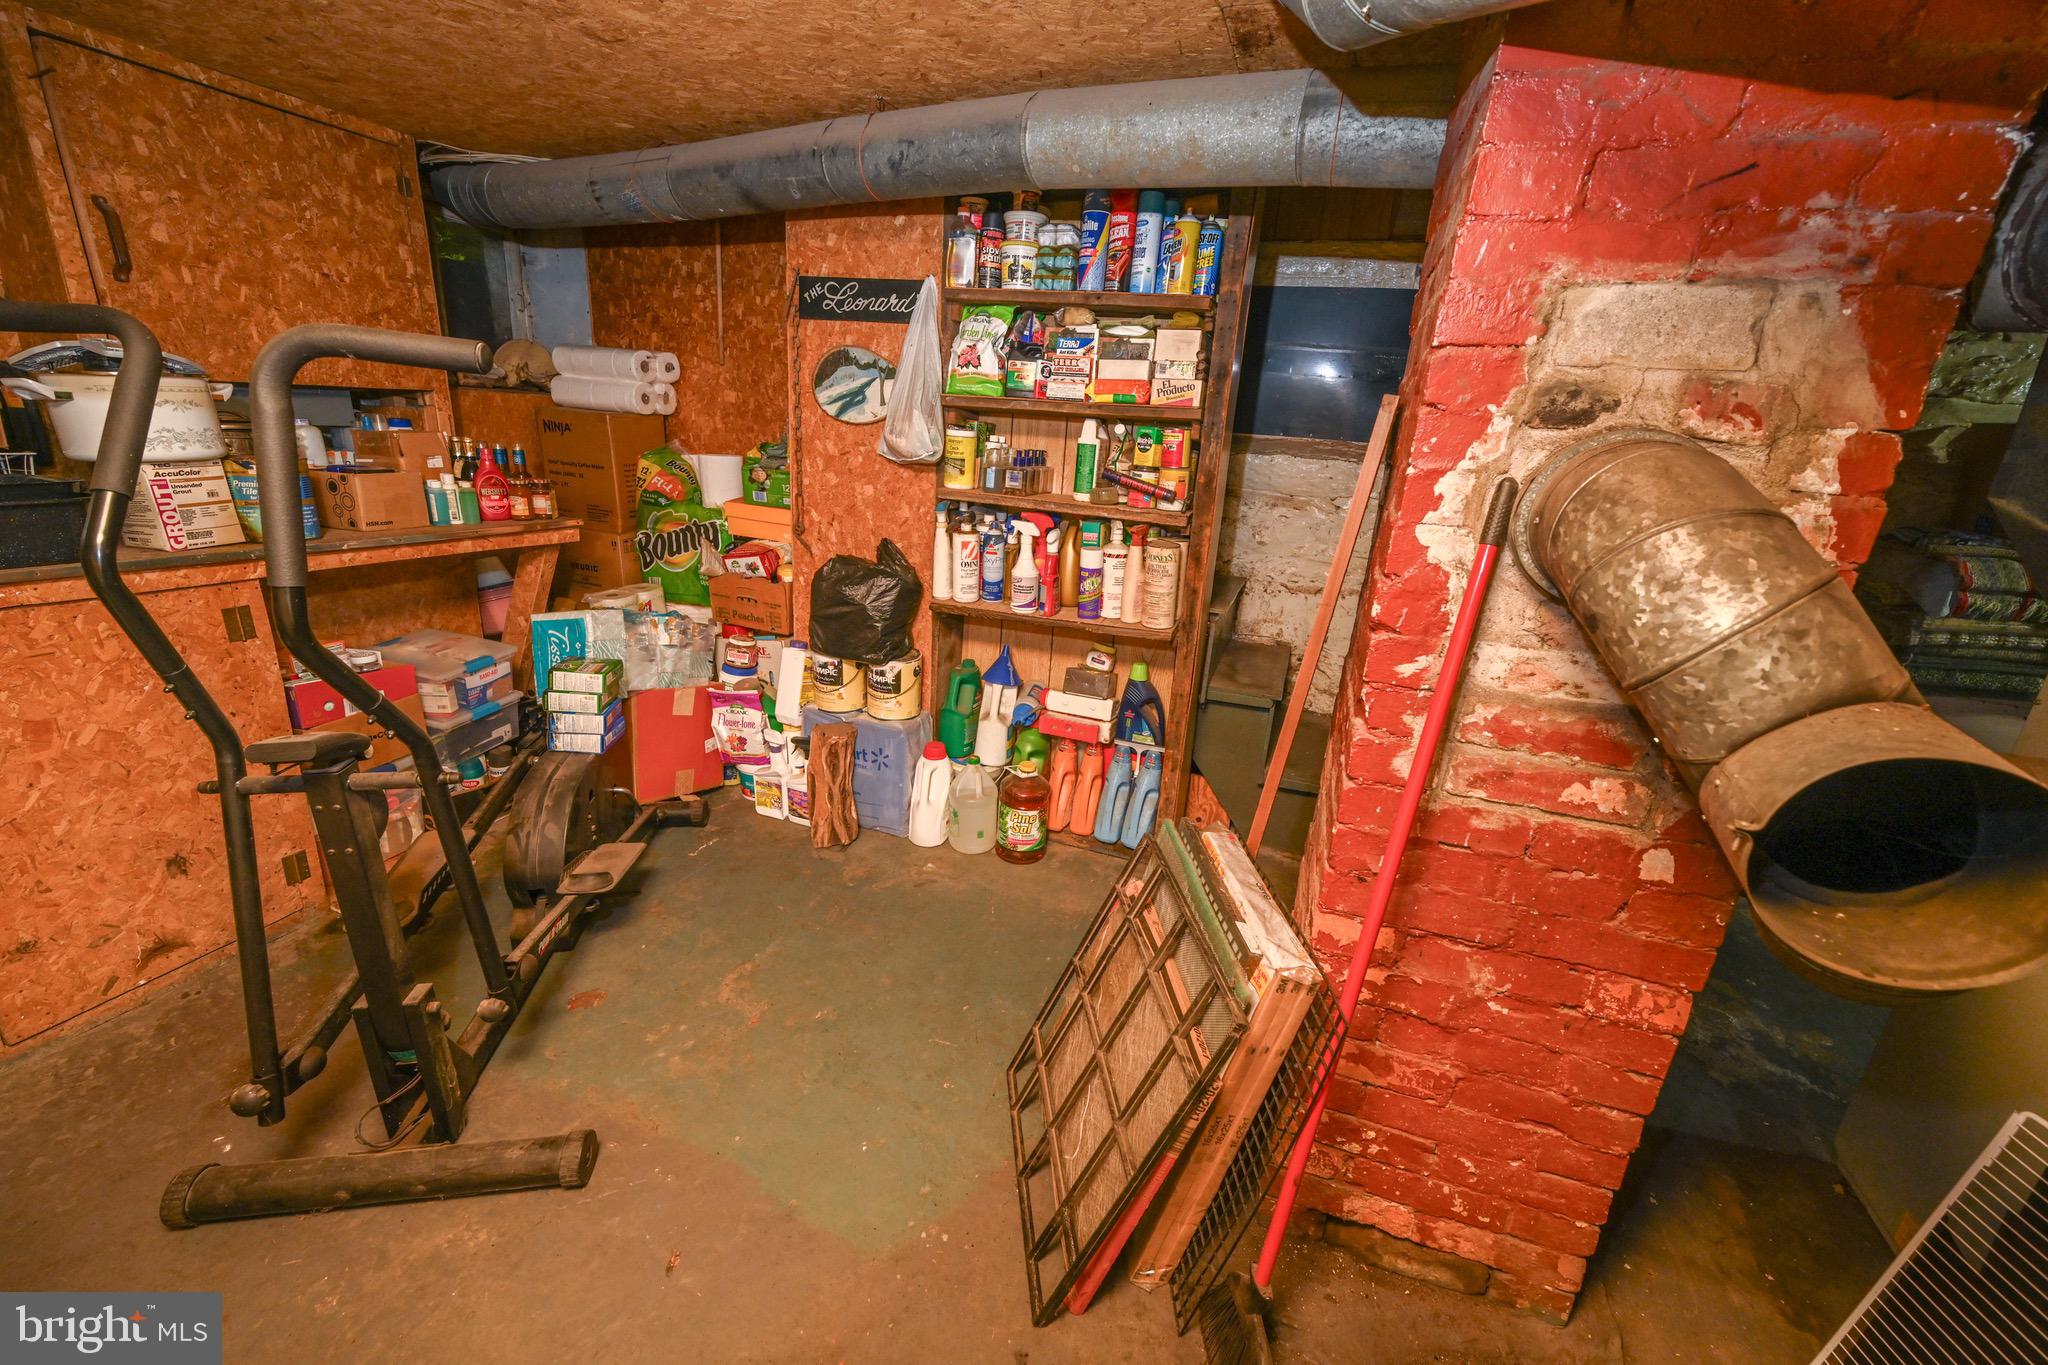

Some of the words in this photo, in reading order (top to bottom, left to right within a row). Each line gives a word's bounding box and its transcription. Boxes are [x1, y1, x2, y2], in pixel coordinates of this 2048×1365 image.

[803, 282, 825, 303] THE
[1059, 339, 1080, 348] TERRO
[1157, 383, 1196, 398] Producto
[543, 419, 571, 436] NINJA
[154, 470, 201, 478] AccuColor
[665, 459, 697, 487] Bounty
[233, 480, 258, 488] Premi
[637, 519, 721, 572] Bounty
[732, 610, 765, 624] Peaches
[480, 669, 499, 681] BAND-AID
[718, 713, 756, 730] Flower-tone
[1010, 811, 1038, 824] Pine
[1215, 1114, 1237, 1146] 16x25x1
